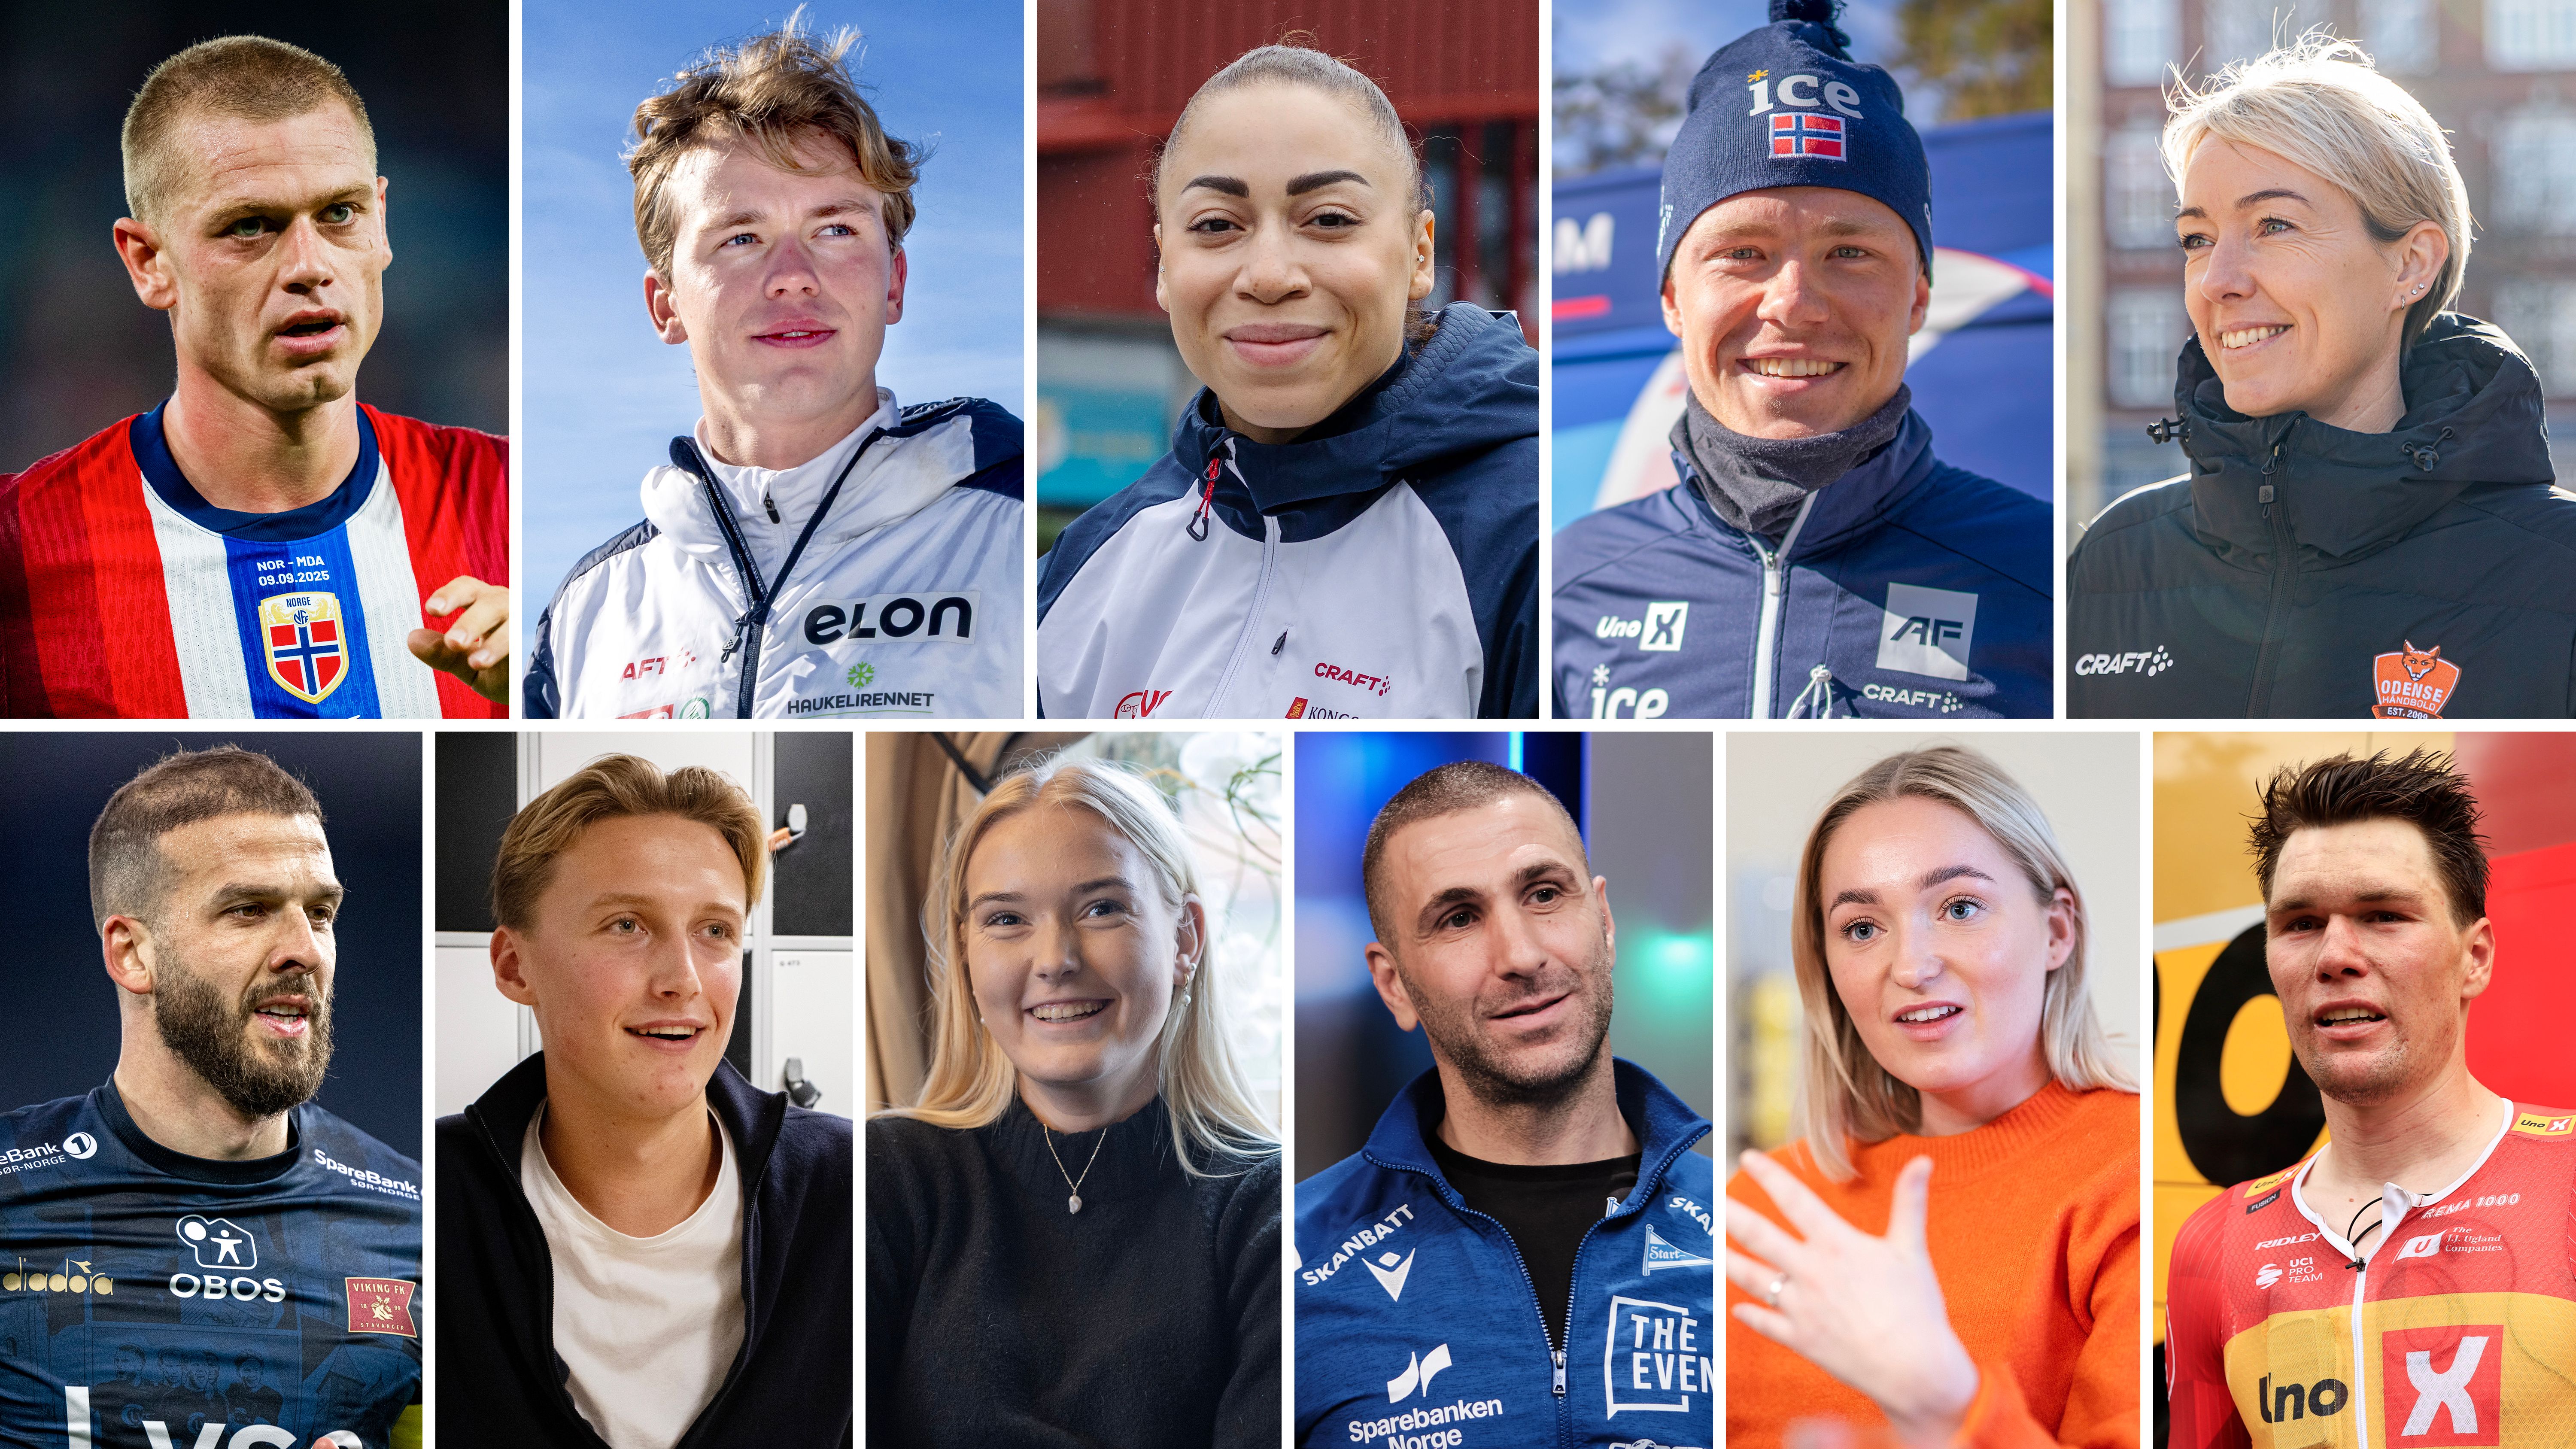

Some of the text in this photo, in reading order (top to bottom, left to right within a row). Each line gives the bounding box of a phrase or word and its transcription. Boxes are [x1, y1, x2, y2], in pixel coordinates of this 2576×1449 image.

[1747, 70, 1864, 119] ice
[256, 560, 286, 571] NOR
[296, 556, 325, 567] MDA
[258, 570, 330, 586] 09.09.2025
[286, 597, 311, 608] NORGE
[1889, 616, 1964, 647] AF
[2075, 651, 2152, 676] CRAFT
[1314, 662, 1382, 691] CRAFT
[1862, 683, 1941, 708] CRAFT
[2381, 680, 2443, 703] ODENSE
[2382, 693, 2436, 711] HÅNDBOLD
[787, 692, 935, 714] HAUKELIRENNET
[2387, 707, 2405, 717] EST.
[2521, 1119, 2545, 1127] Uno
[314, 1149, 418, 1194] SpareBank
[350, 1179, 420, 1201] SØR-NORGE
[2251, 1193, 2276, 1211] FUSION
[2421, 1193, 2521, 1219] REMA 1000
[1669, 1197, 1713, 1236] SKA
[1302, 1203, 1414, 1286] SKANBATT
[2255, 1232, 2321, 1250] RIDLEY
[2445, 1245, 2503, 1254] Companies
[2464, 1234, 2502, 1244] Ugland
[1649, 1246, 1686, 1259] Start
[2290, 1257, 2313, 1267] UCI
[3, 1257, 113, 1296] diadora
[2289, 1266, 2314, 1276] PRO
[2289, 1273, 2323, 1283] TEAM
[169, 1273, 286, 1303] OBOS
[352, 1283, 405, 1295] VIKING FK
[1631, 1314, 1698, 1352] THE
[2401, 1336, 2490, 1437] X
[1349, 1399, 1503, 1444] Sparebanken
